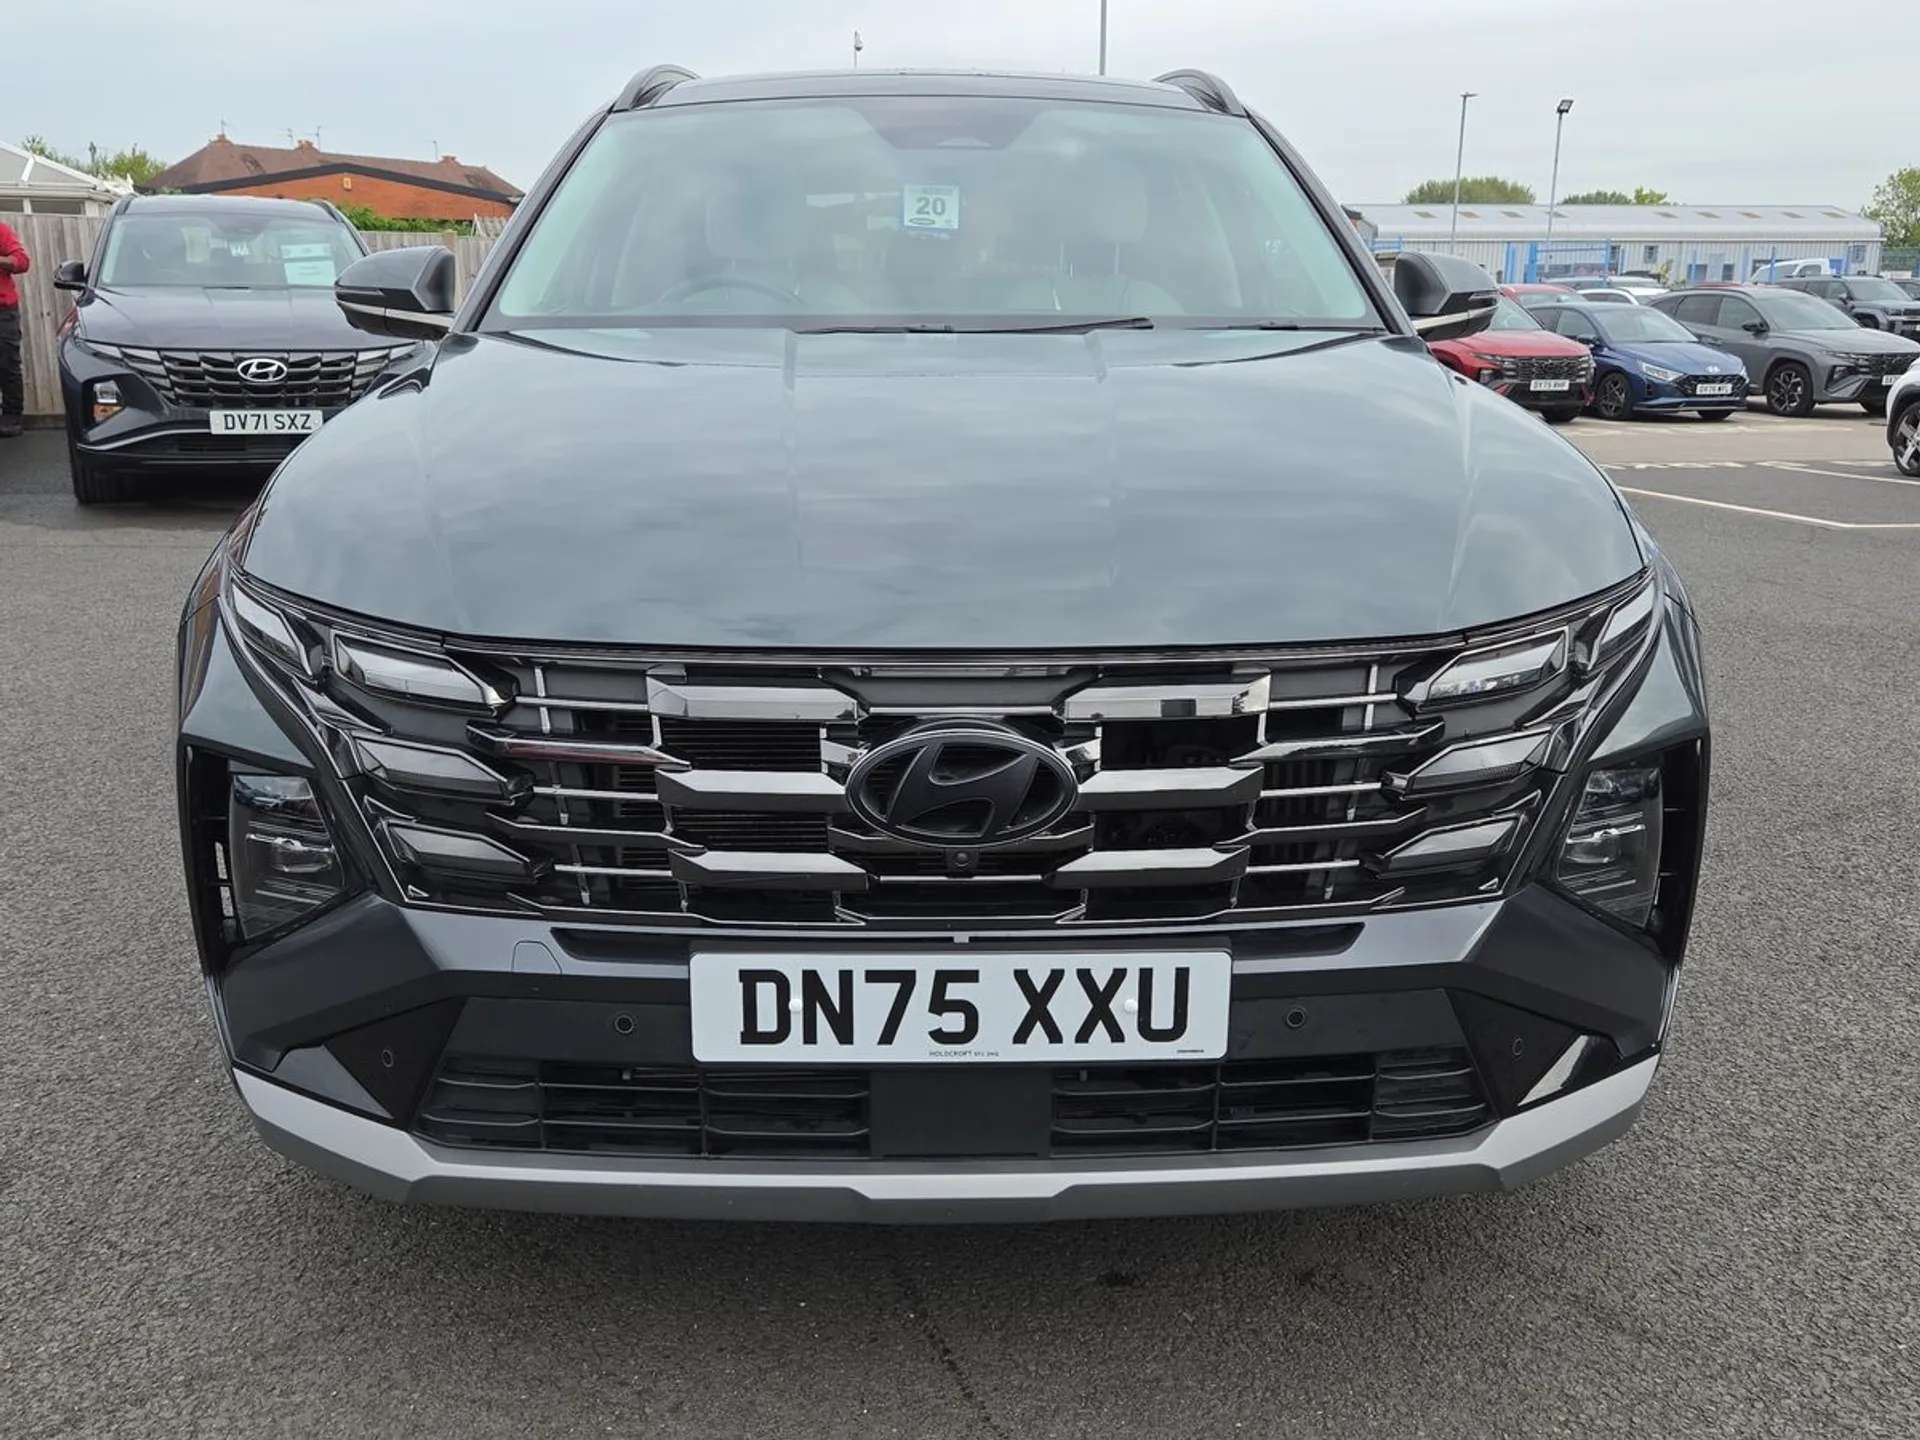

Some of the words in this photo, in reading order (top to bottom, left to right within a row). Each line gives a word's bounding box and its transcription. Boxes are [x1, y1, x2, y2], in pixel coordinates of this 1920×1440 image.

[915, 196, 946, 216] 20
[223, 413, 268, 430] DV71
[273, 413, 312, 430] SXZ
[738, 968, 980, 1046] DN75
[1012, 966, 1190, 1044] XXU
